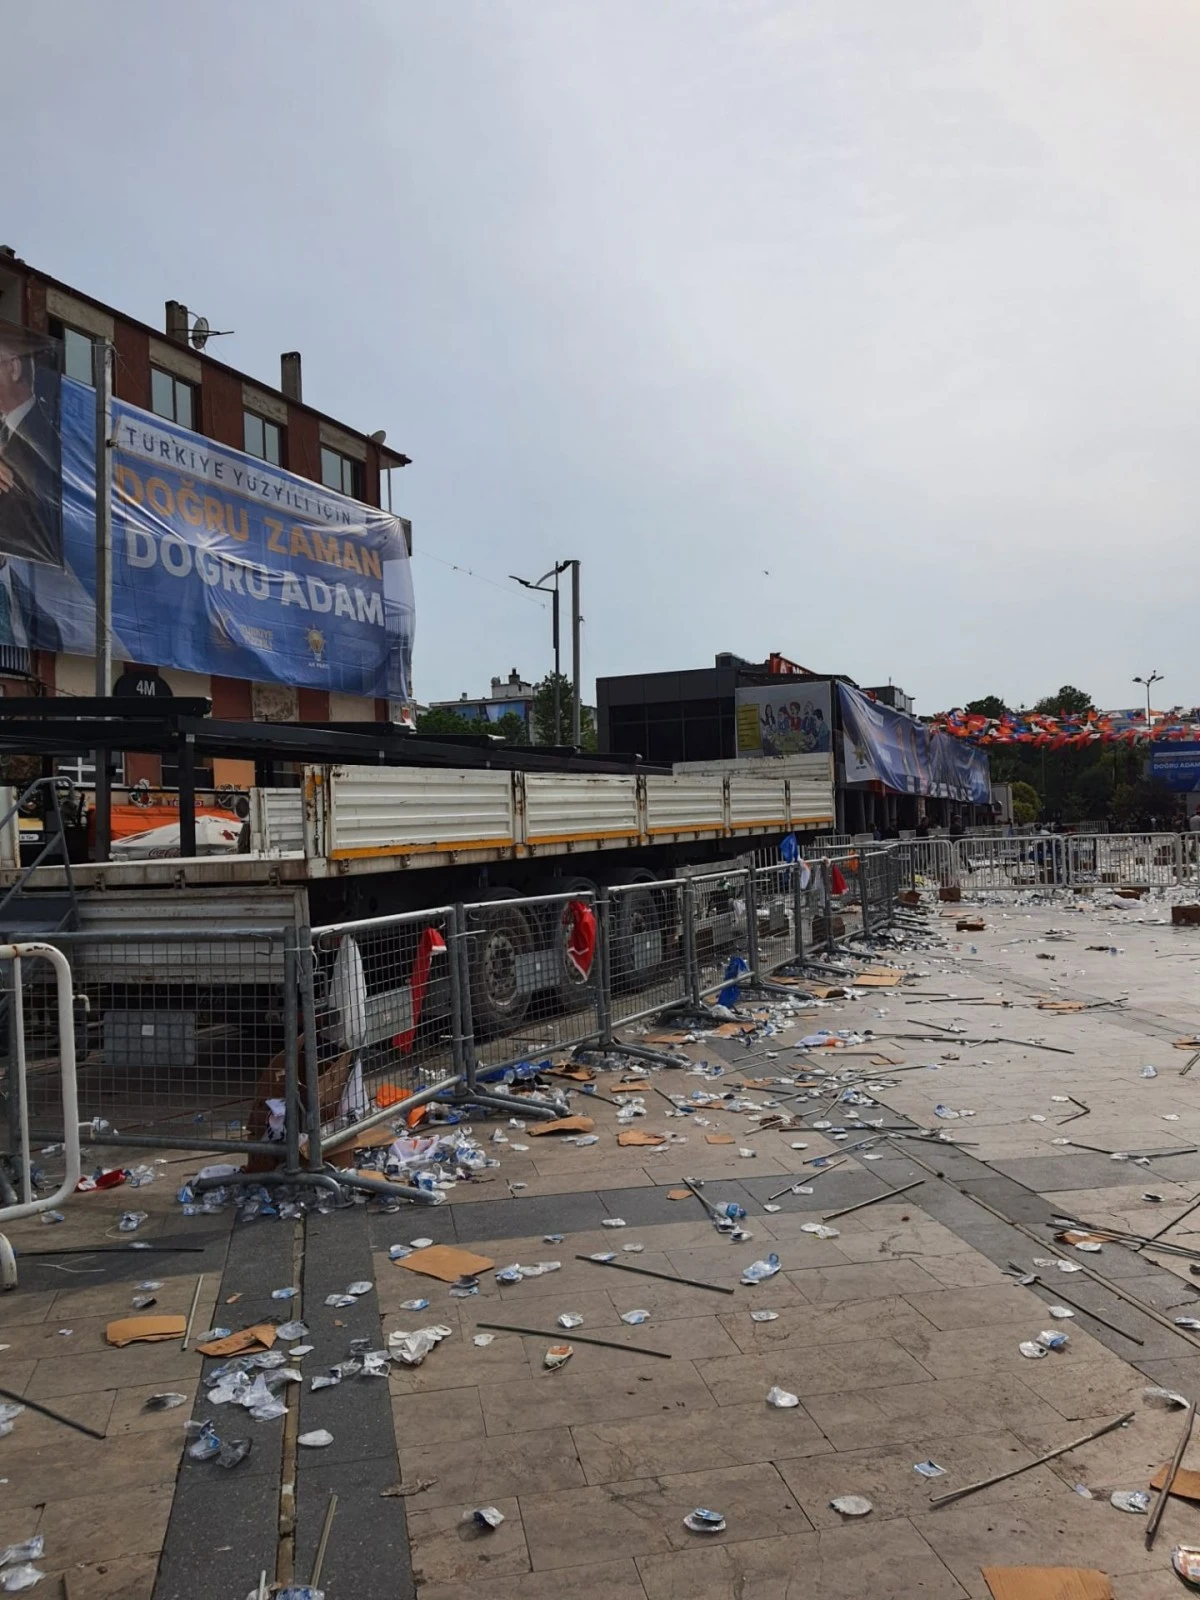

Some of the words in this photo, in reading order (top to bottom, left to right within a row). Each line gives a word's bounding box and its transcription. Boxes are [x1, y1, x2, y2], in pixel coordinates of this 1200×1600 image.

[115, 463, 249, 543] DOĞRU
[264, 515, 382, 580] ZAMAN
[126, 425, 223, 480] TÜRKİYE
[234, 468, 309, 512] YÜZYILI
[317, 499, 351, 525] İÇİN
[126, 524, 269, 601] DOĞRU
[281, 569, 385, 627] ADAM
[136, 680, 156, 696] 4M
